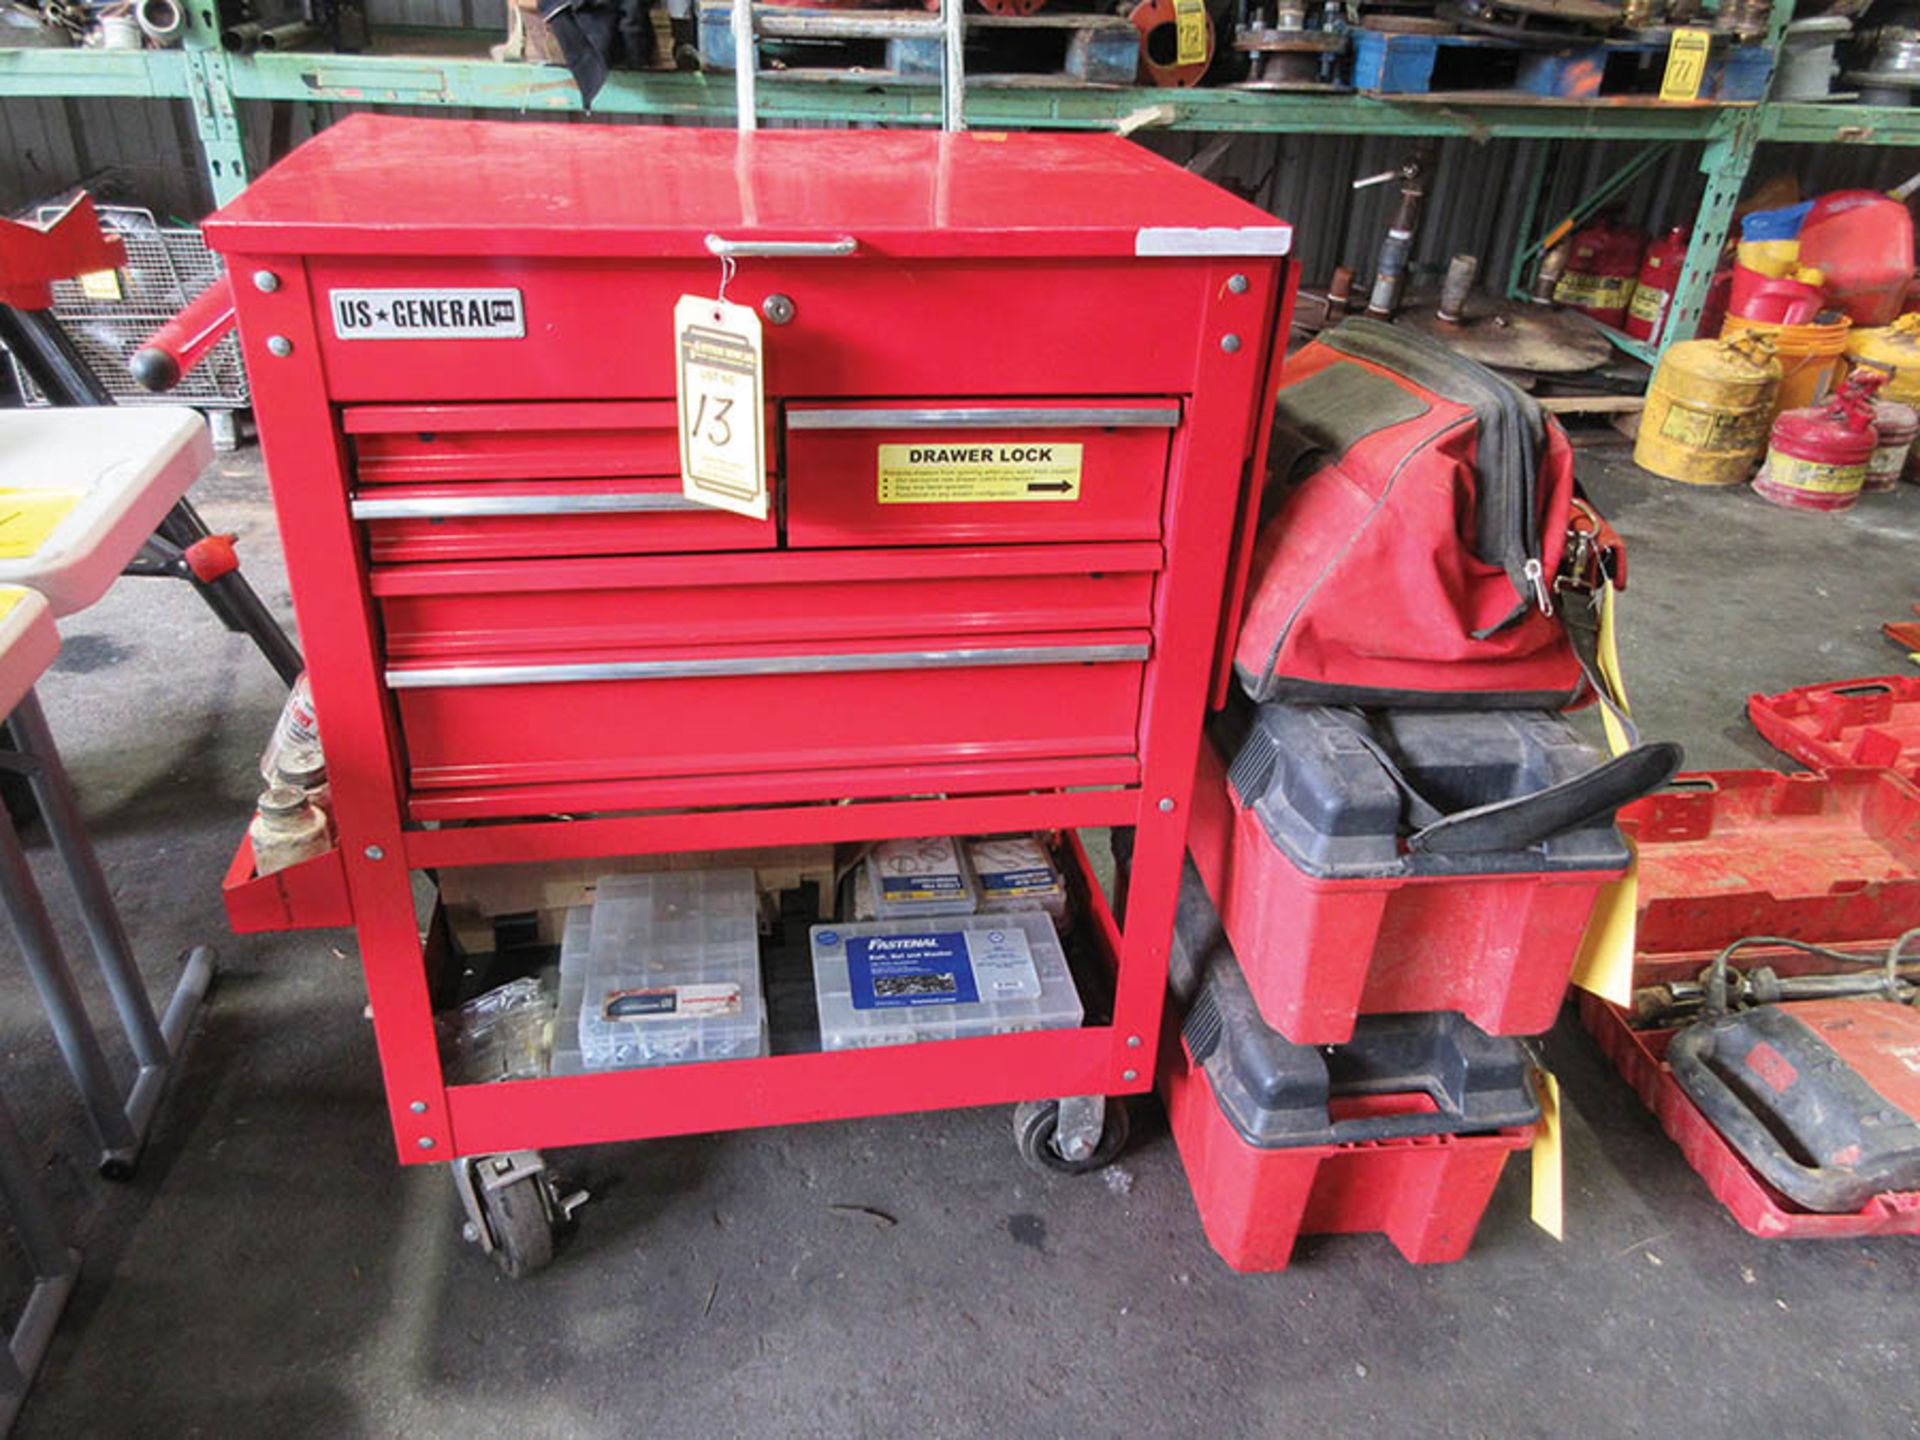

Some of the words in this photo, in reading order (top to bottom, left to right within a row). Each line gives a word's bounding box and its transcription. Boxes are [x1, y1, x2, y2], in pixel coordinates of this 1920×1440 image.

[340, 300, 373, 328] US
[392, 299, 496, 328] GENERAL
[692, 393, 734, 446] 13
[909, 449, 994, 463] DRAWER
[1000, 448, 1053, 462] LOCK
